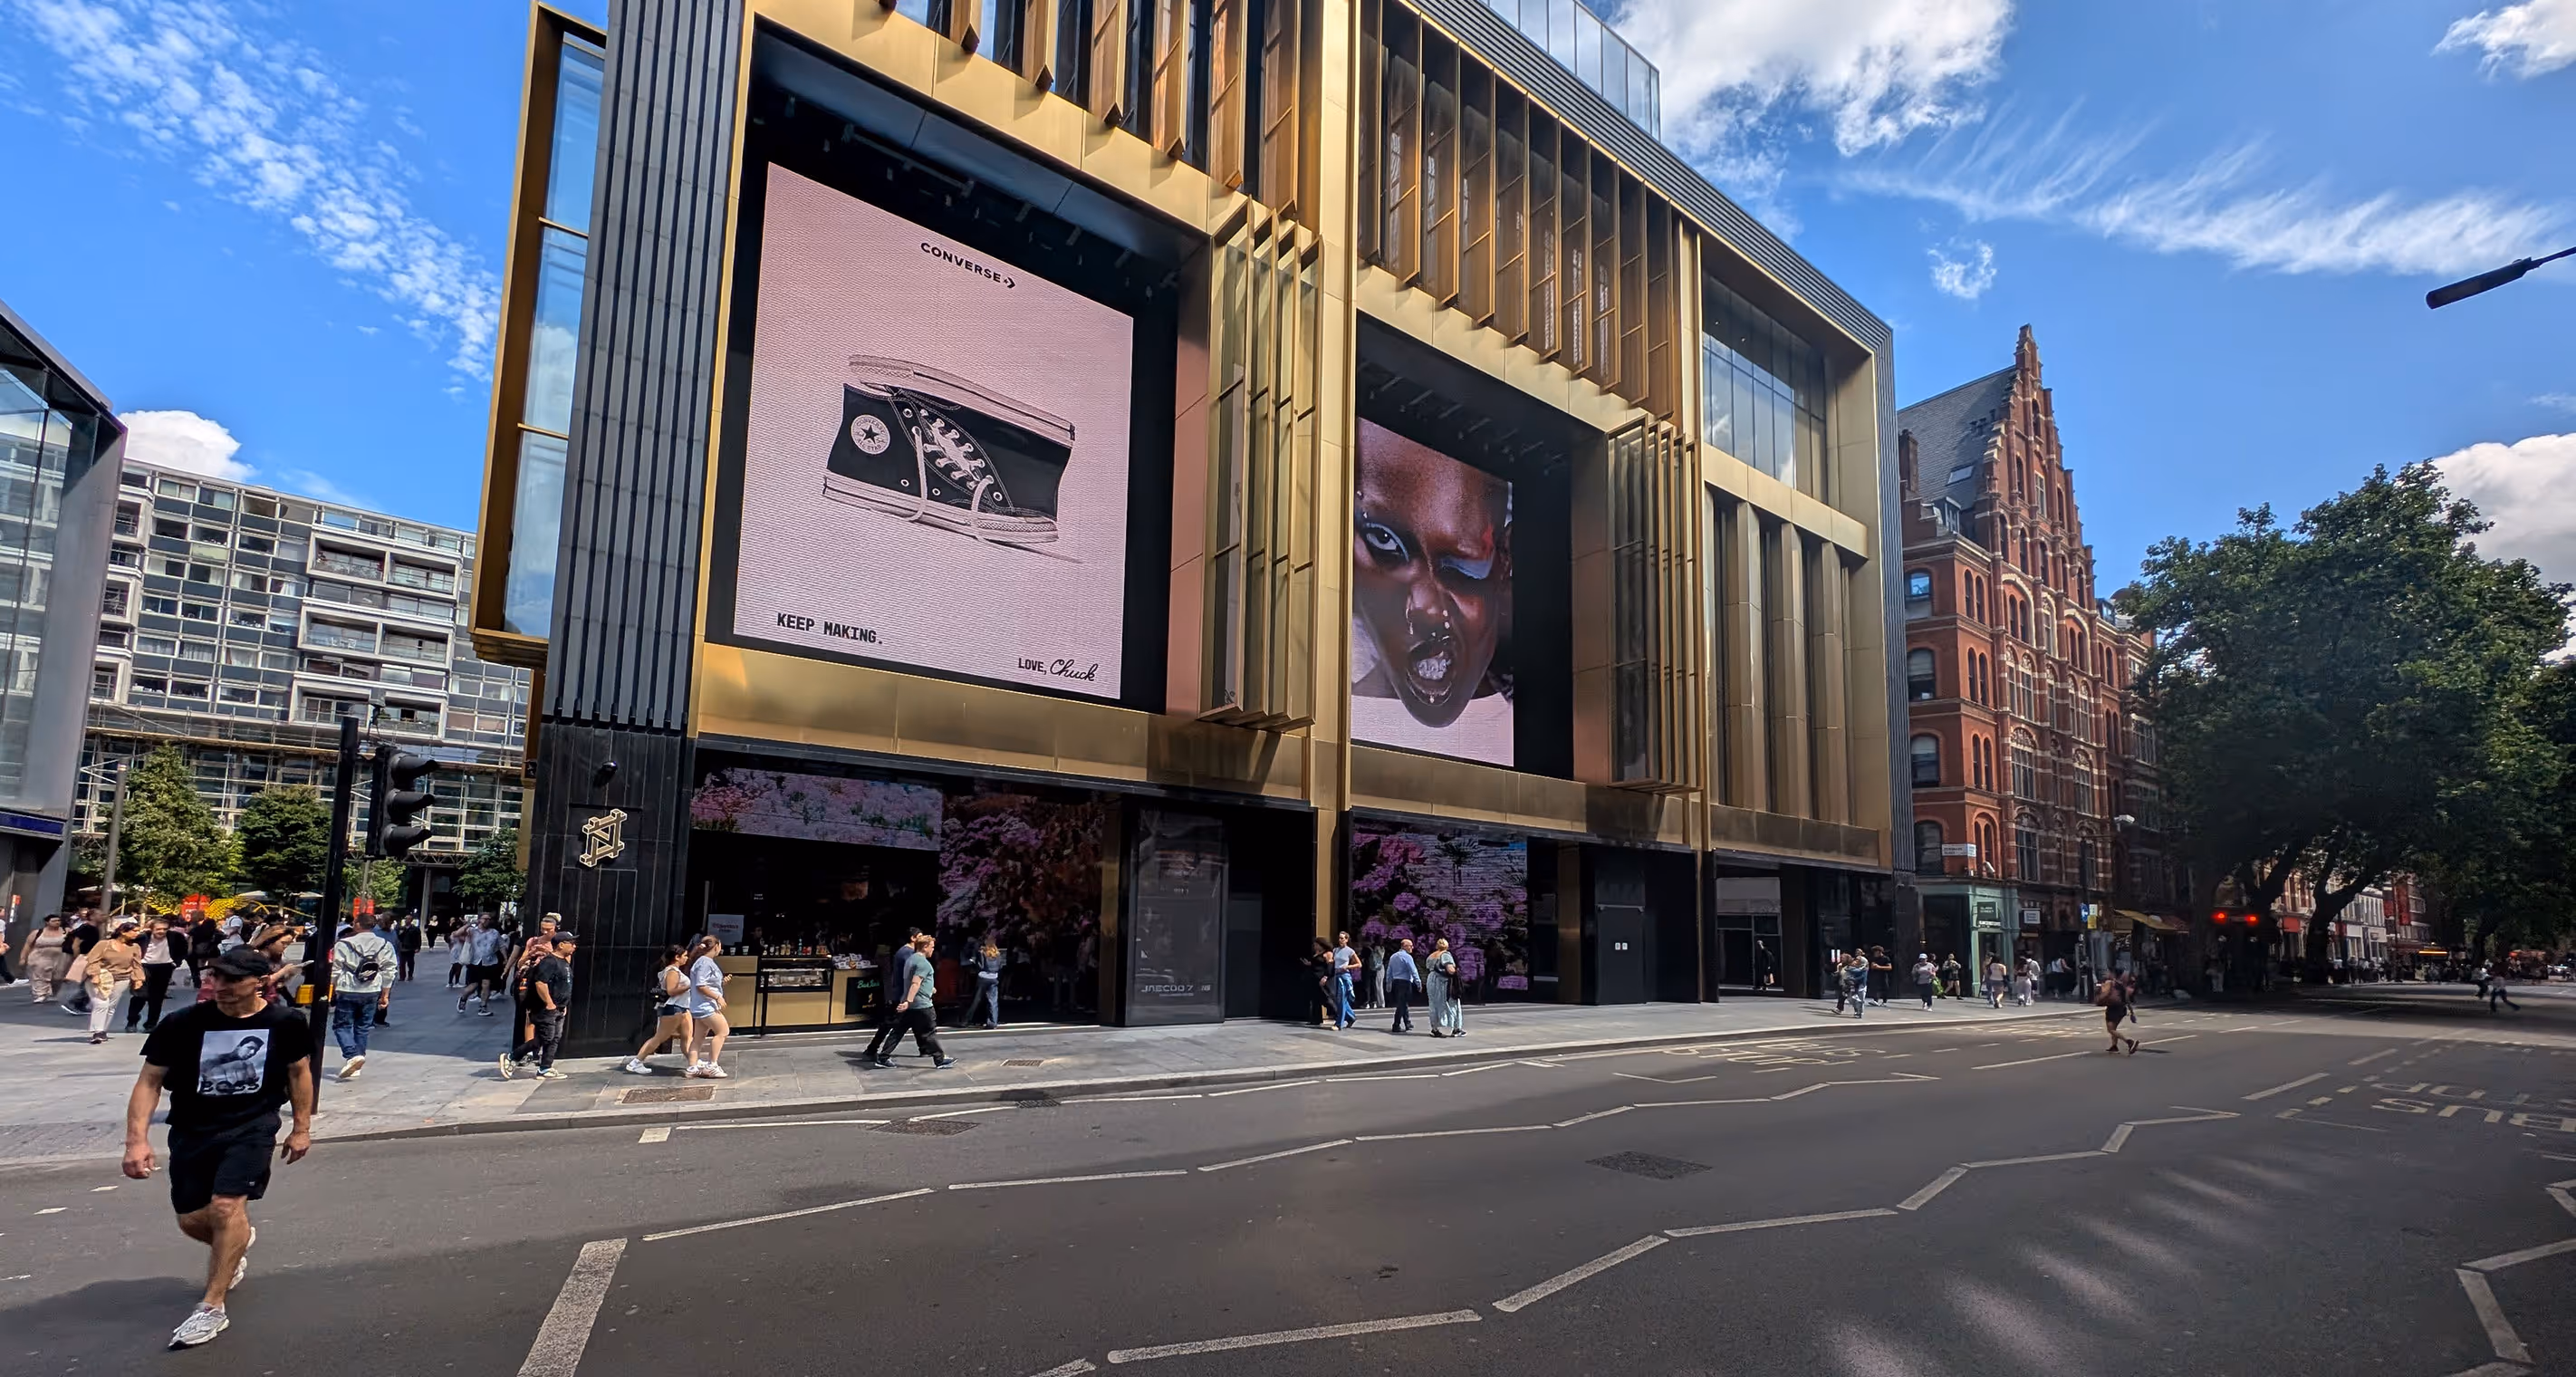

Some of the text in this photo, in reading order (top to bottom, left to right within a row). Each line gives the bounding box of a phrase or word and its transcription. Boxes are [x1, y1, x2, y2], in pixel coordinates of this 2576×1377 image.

[920, 242, 1002, 284] CONVERSE
[776, 612, 883, 645] KEEP MAKING.
[1017, 657, 1099, 682] LOVE, Chuck
